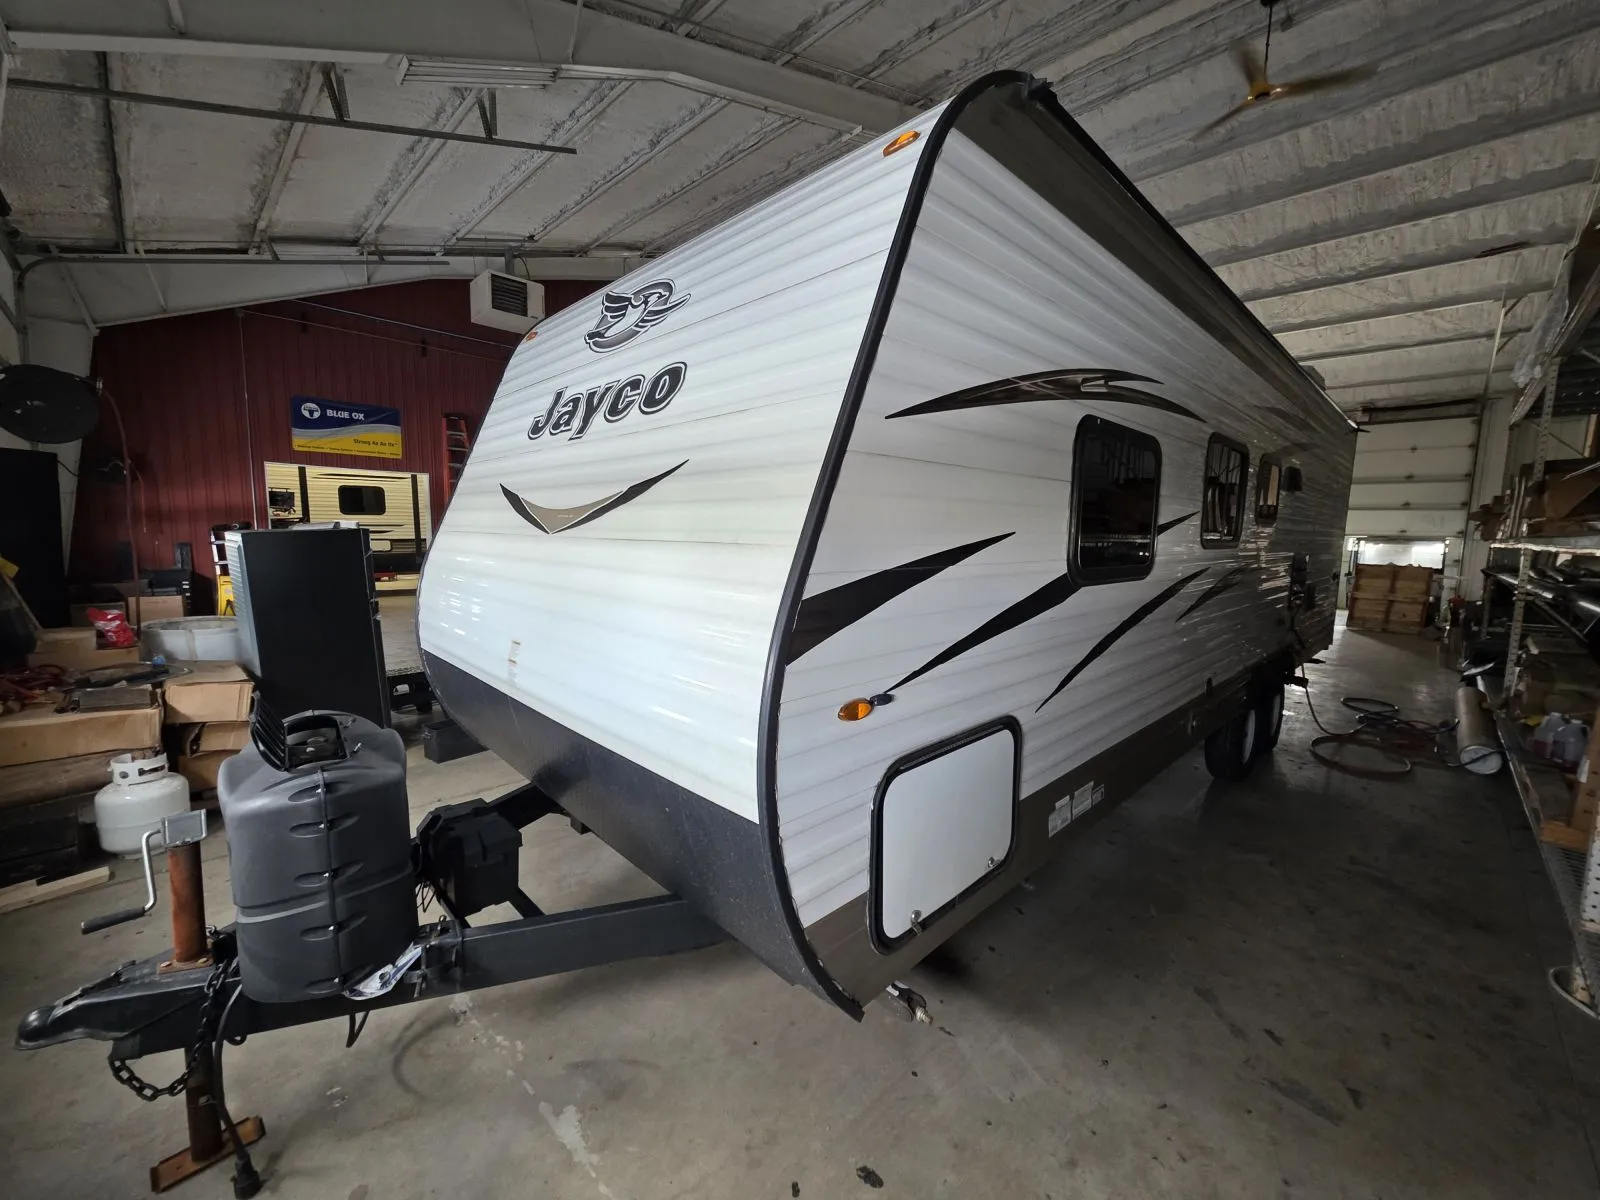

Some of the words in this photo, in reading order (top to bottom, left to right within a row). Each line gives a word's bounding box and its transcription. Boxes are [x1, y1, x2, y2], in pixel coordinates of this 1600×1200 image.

[326, 409, 350, 419] BLUE
[351, 412, 365, 420] OX
[528, 361, 687, 441] Jayco
